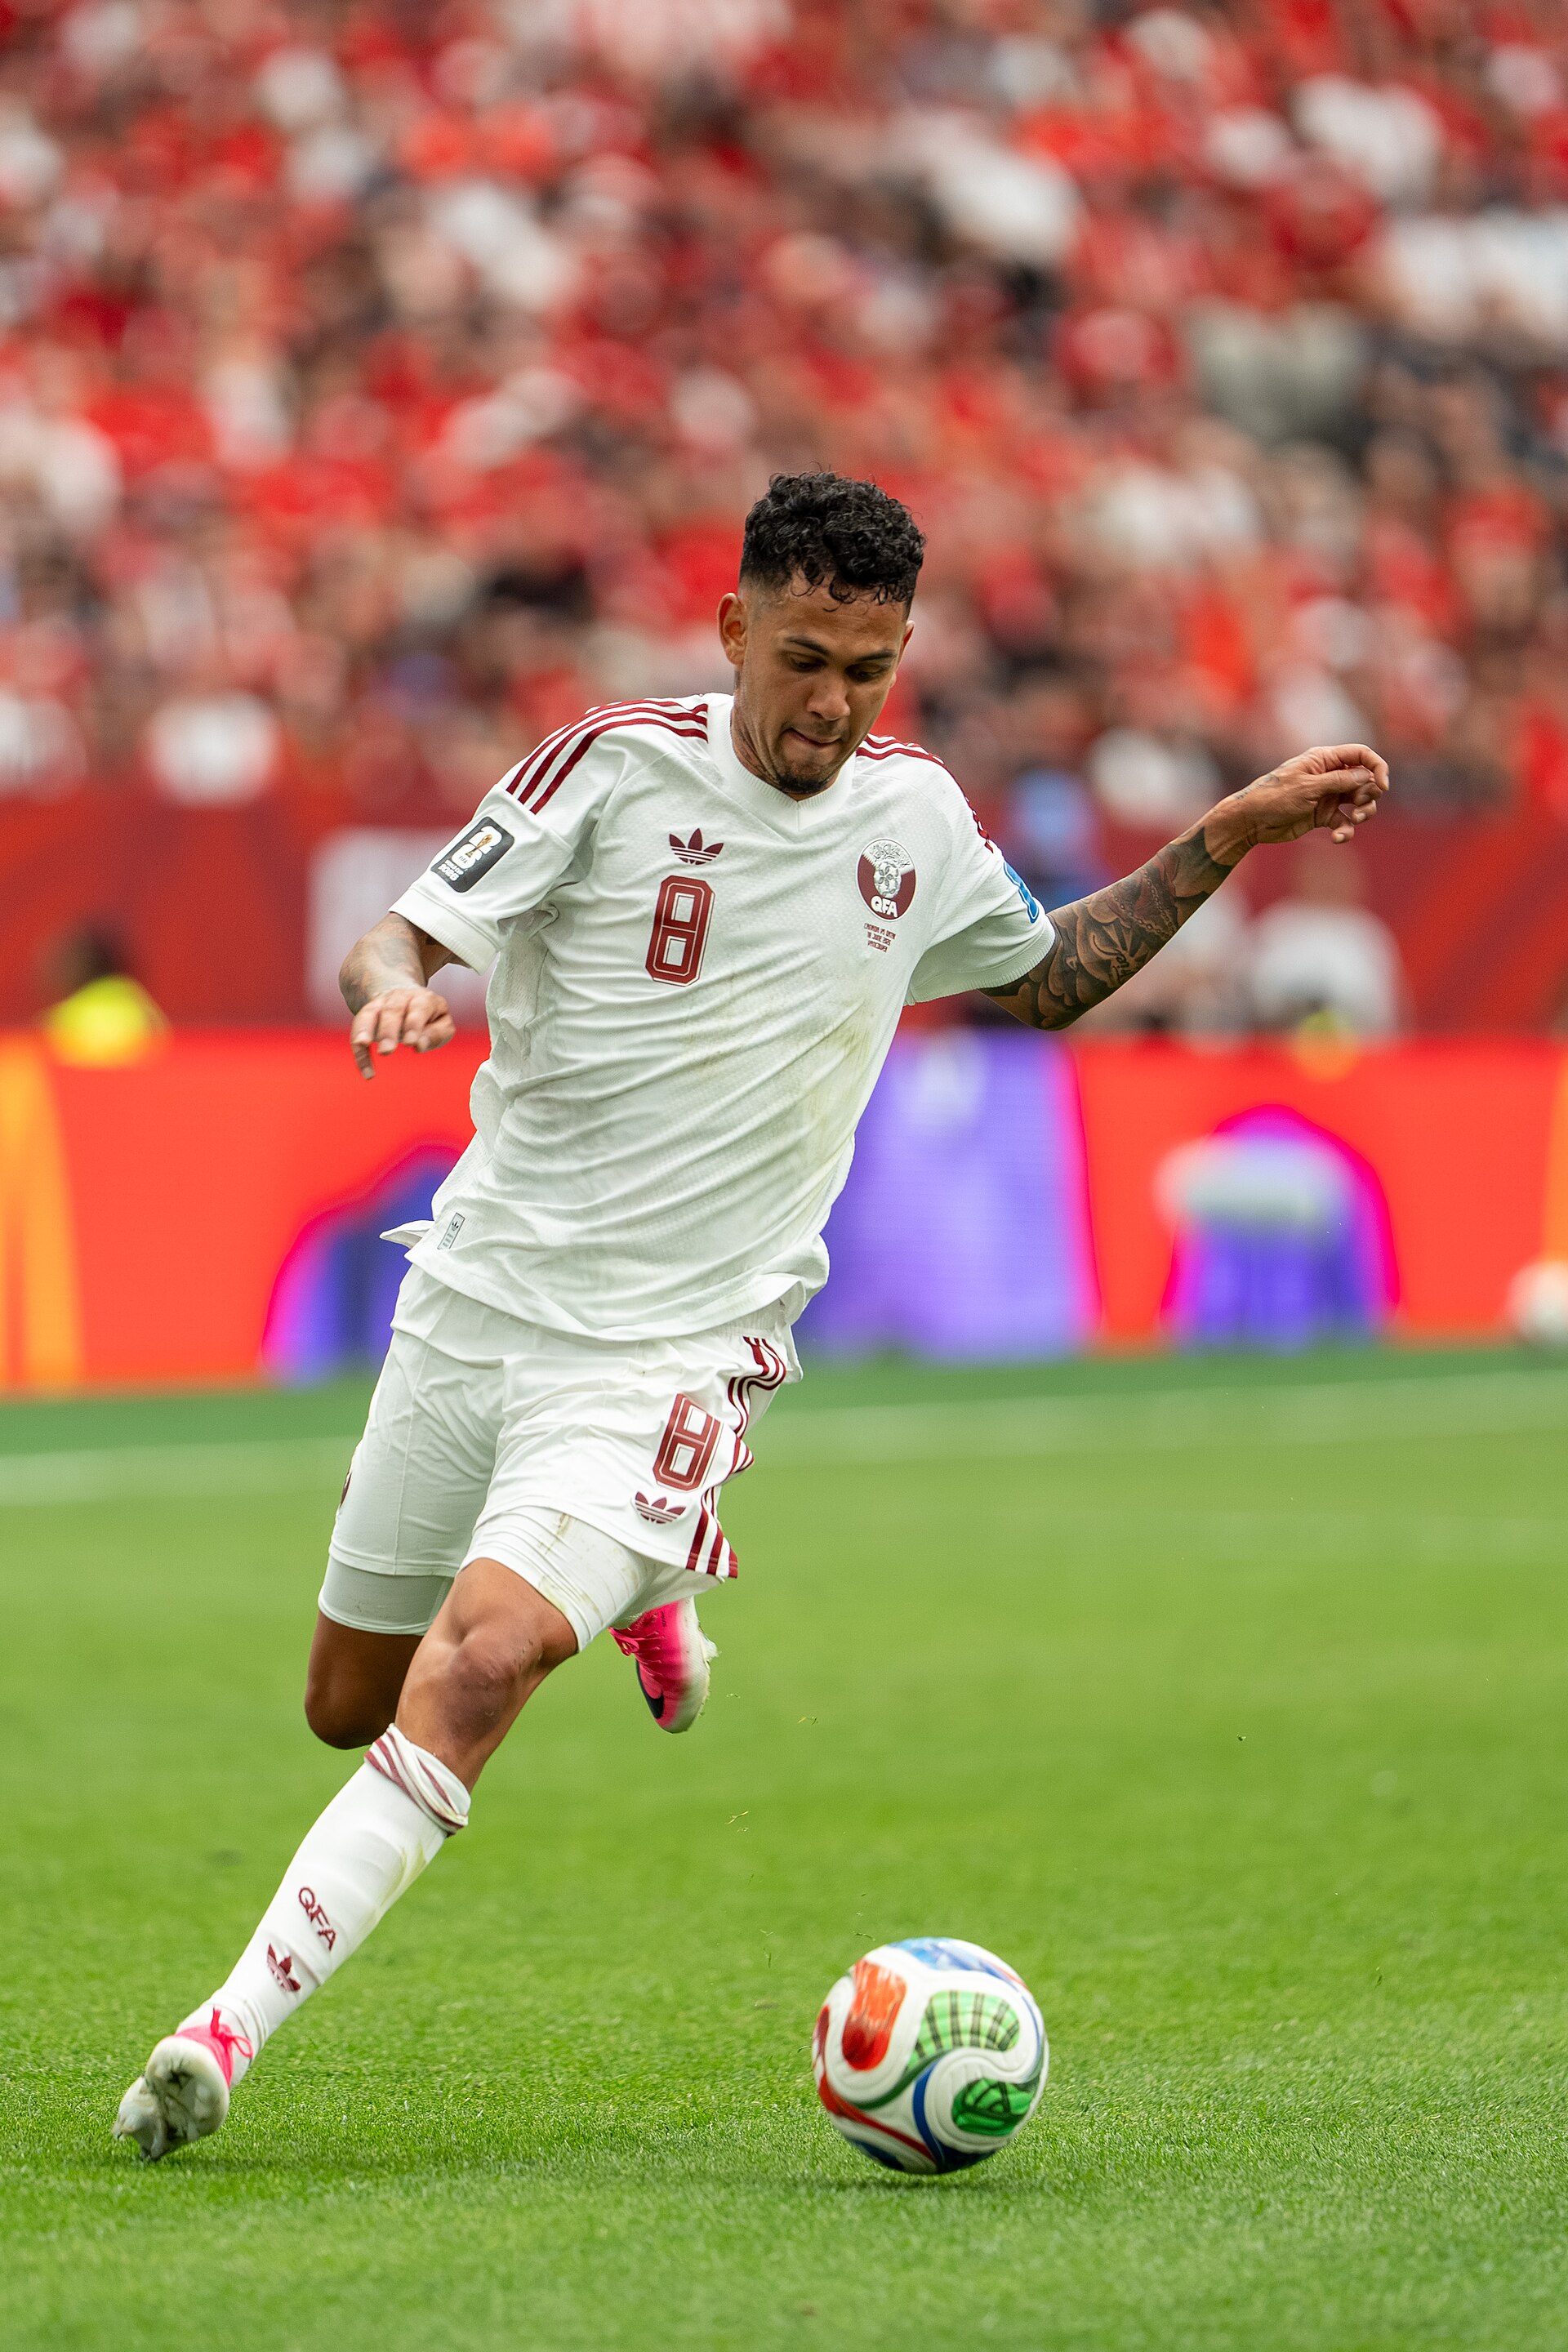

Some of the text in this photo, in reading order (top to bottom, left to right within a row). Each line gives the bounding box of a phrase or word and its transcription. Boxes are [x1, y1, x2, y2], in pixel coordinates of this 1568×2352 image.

[454, 867, 465, 875] CUP
[458, 855, 468, 864] FIFA
[438, 863, 460, 881] 2026
[871, 895, 898, 918] QFA
[645, 875, 716, 987] 8
[653, 1392, 724, 1493] 8
[298, 1886, 336, 1952] QFA
